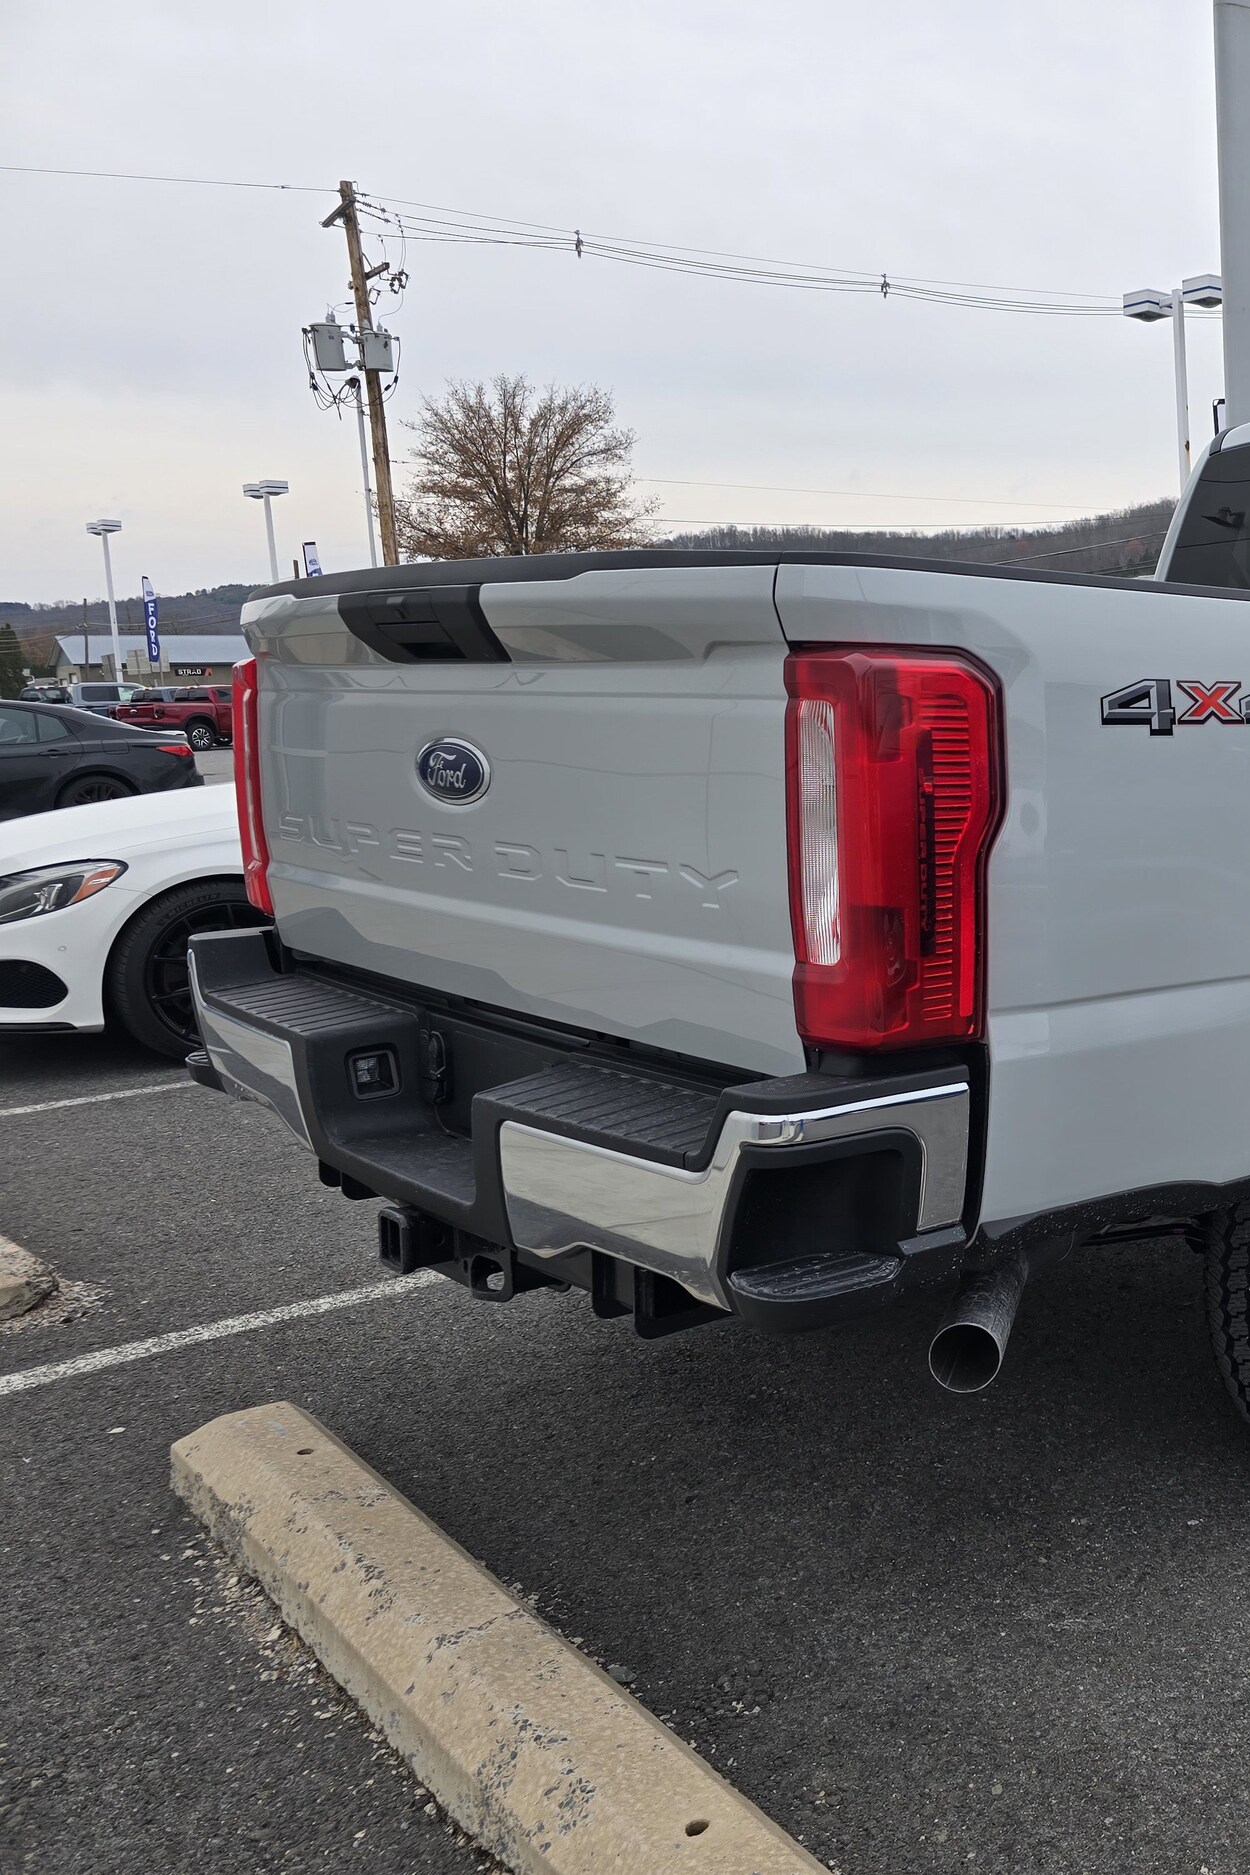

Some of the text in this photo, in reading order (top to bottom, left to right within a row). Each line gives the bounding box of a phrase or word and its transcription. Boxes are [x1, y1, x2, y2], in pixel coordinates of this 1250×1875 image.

[148, 603, 158, 656] FORD
[427, 751, 467, 788] Ford
[278, 815, 739, 909] SUPER DUTY
